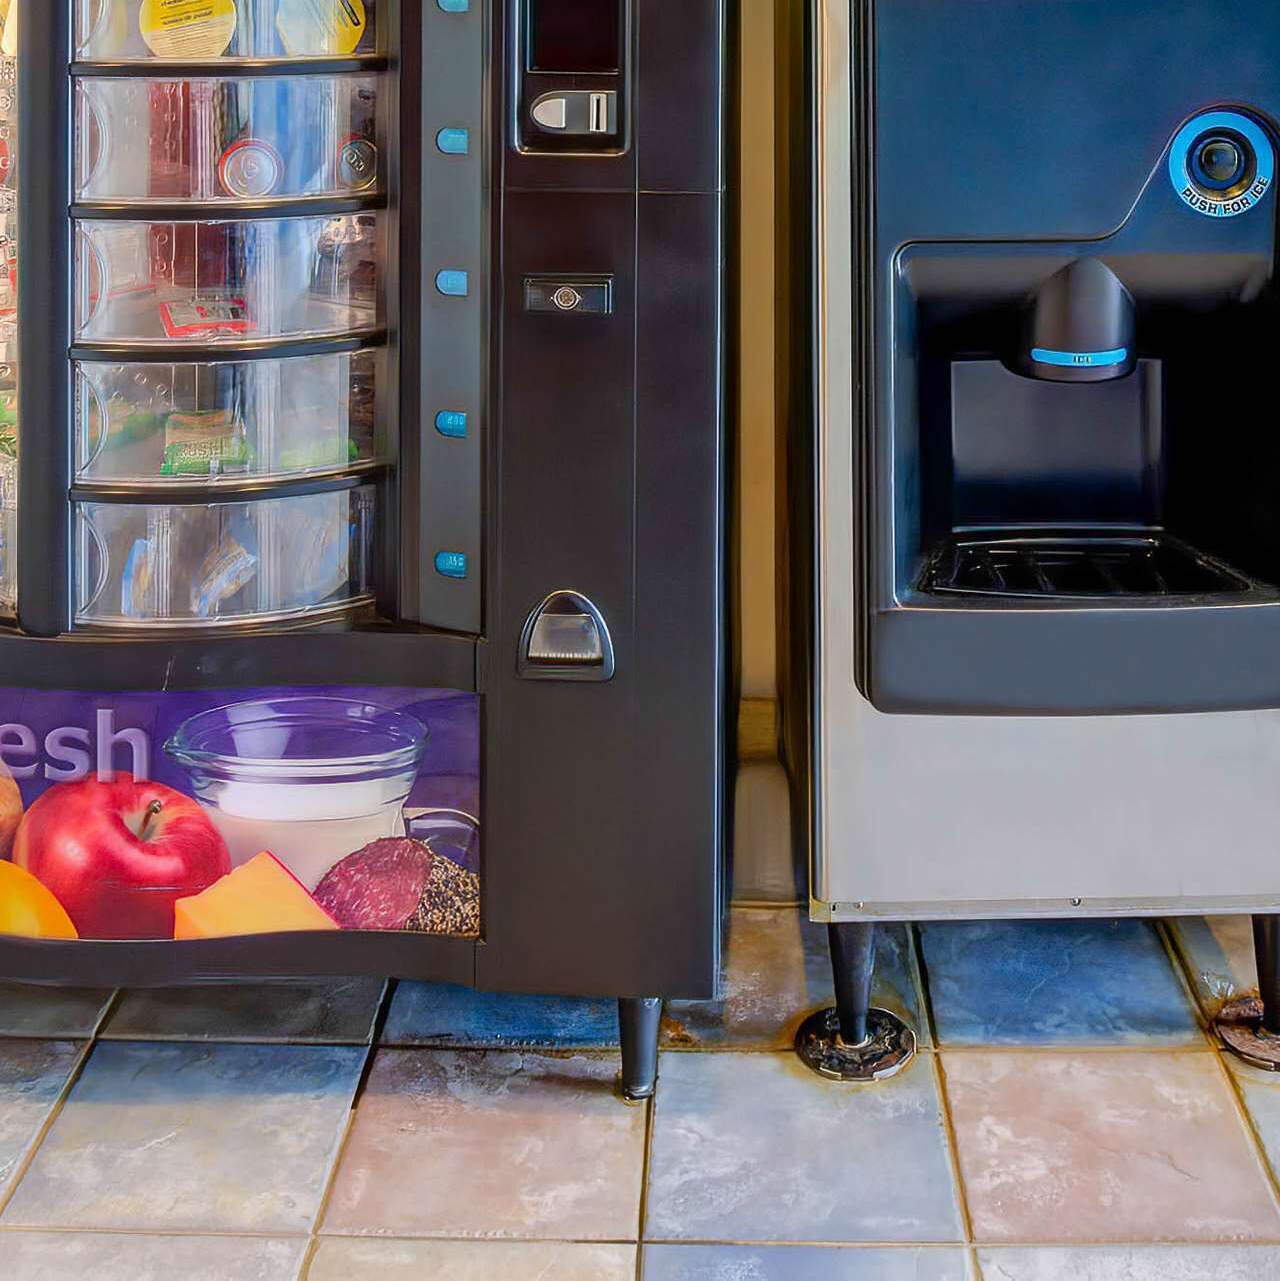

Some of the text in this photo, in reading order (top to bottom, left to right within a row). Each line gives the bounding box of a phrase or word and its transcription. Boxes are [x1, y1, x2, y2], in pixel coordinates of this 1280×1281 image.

[1182, 176, 1268, 215] PUSH FOR ICE
